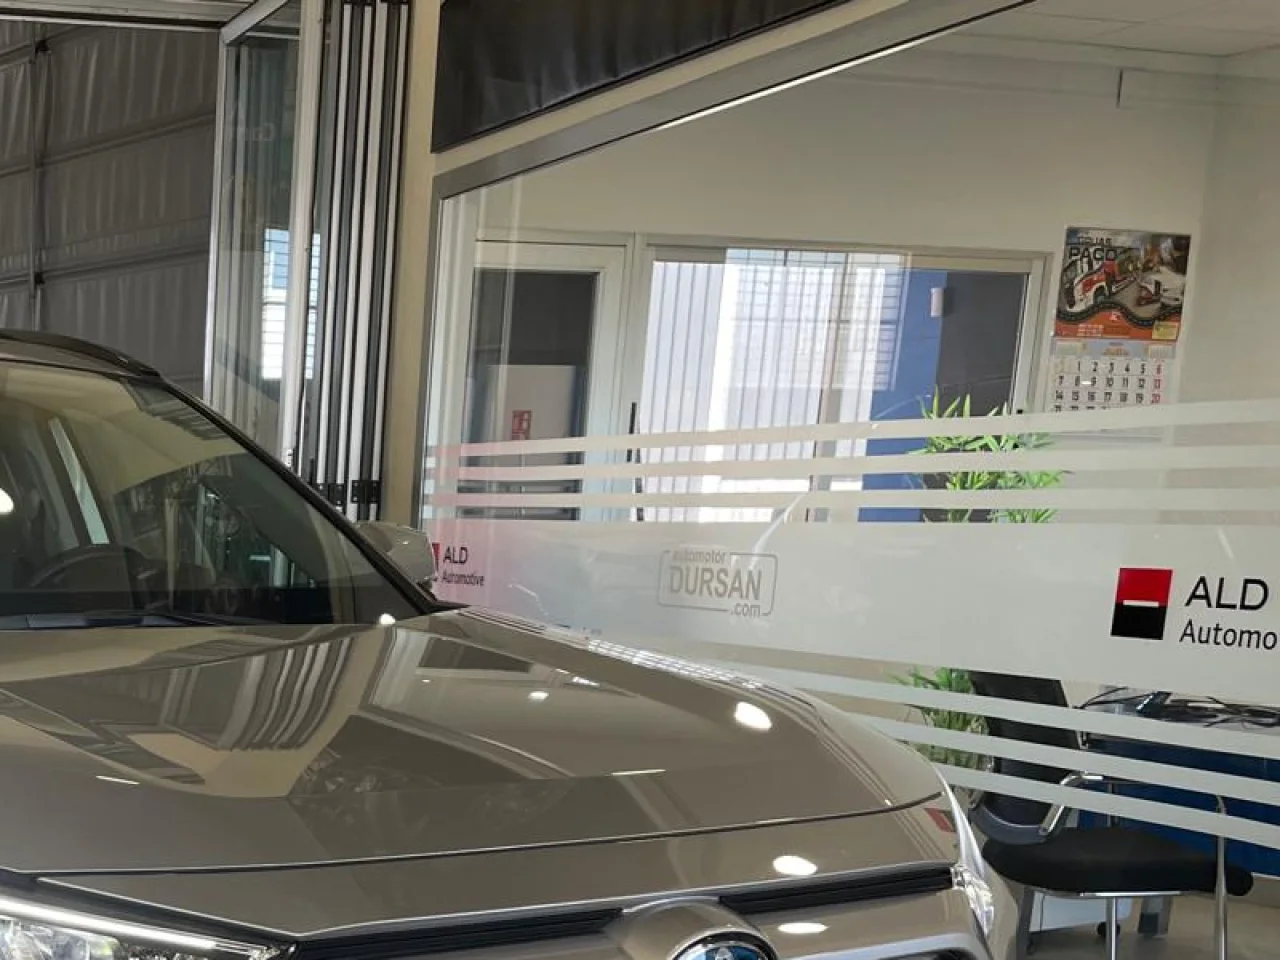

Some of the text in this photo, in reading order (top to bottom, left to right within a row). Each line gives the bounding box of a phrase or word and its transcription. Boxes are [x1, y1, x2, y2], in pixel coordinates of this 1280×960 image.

[1068, 247, 1118, 261] PACO
[443, 546, 468, 565] ALD
[669, 565, 762, 600] DURSAN
[1184, 576, 1269, 610] ALD
[730, 603, 761, 618] .com
[1179, 619, 1277, 650] Automo
